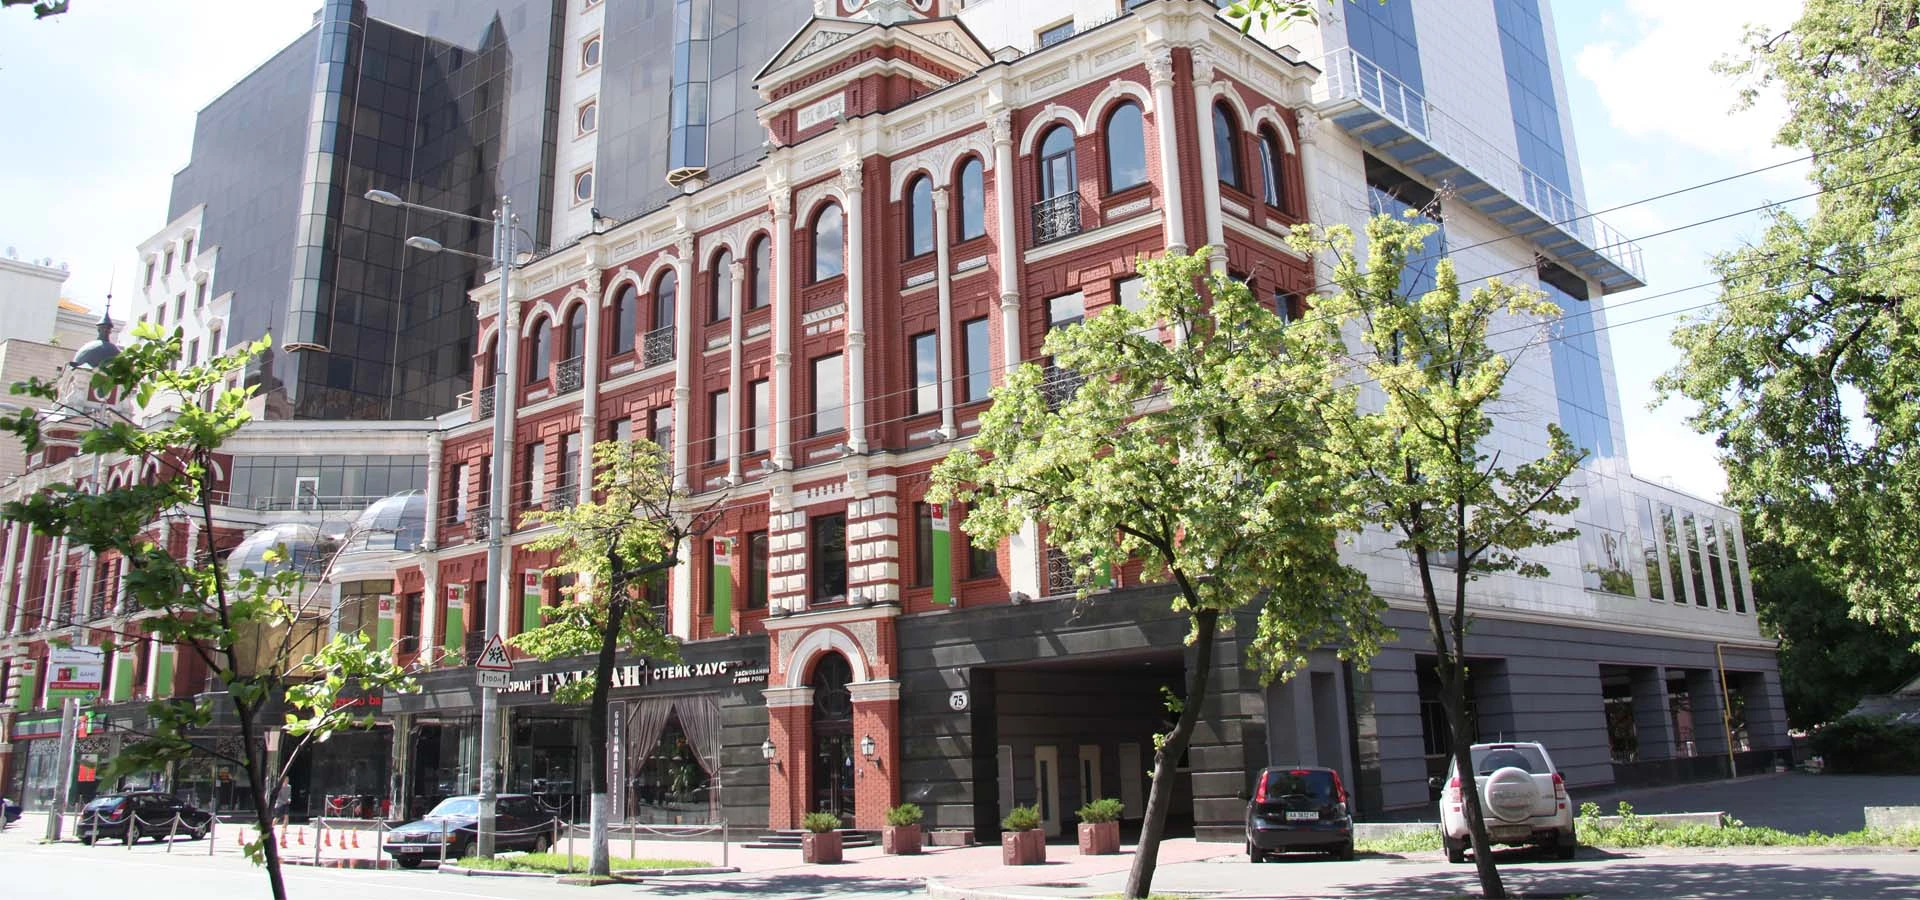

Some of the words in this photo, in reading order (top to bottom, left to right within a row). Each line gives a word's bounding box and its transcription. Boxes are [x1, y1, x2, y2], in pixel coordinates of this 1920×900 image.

[497, 680, 531, 693] ОРАН
[653, 661, 727, 681] СТЕЙК-ХАУС
[953, 695, 964, 706] 75
